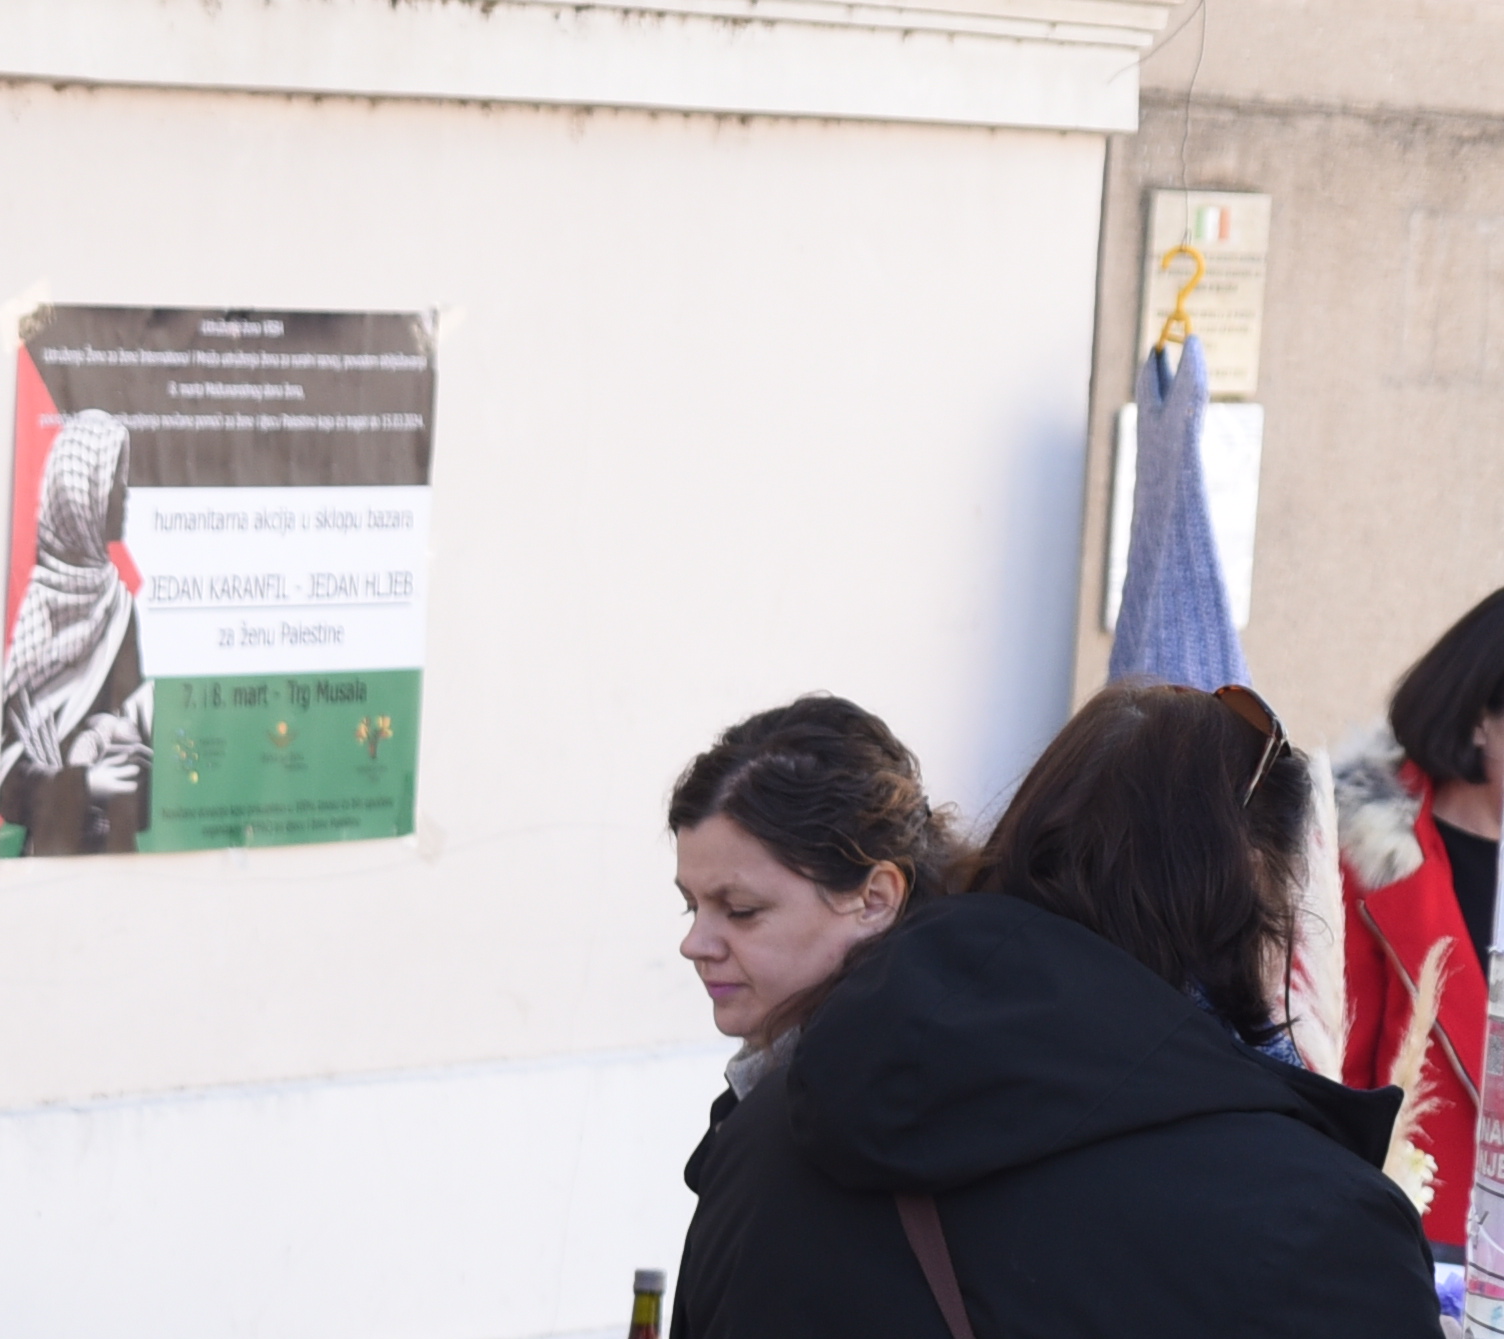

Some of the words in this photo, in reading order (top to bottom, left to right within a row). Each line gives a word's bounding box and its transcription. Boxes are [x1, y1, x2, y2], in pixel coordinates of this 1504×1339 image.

[155, 507, 248, 532] humanitarna
[254, 508, 295, 536] akcija
[302, 512, 311, 530] u
[315, 507, 362, 535] sklopu
[367, 506, 414, 529] bazara
[147, 574, 204, 602] JEDAN
[209, 572, 288, 600] KARANFIL
[307, 572, 360, 598] JEDAN
[365, 570, 414, 597] HLJEB
[219, 627, 235, 647] za
[241, 620, 276, 647] ženu
[281, 622, 345, 645] Palestine
[234, 683, 268, 706] mart
[287, 680, 311, 711] Trg
[317, 678, 368, 704] Musala
